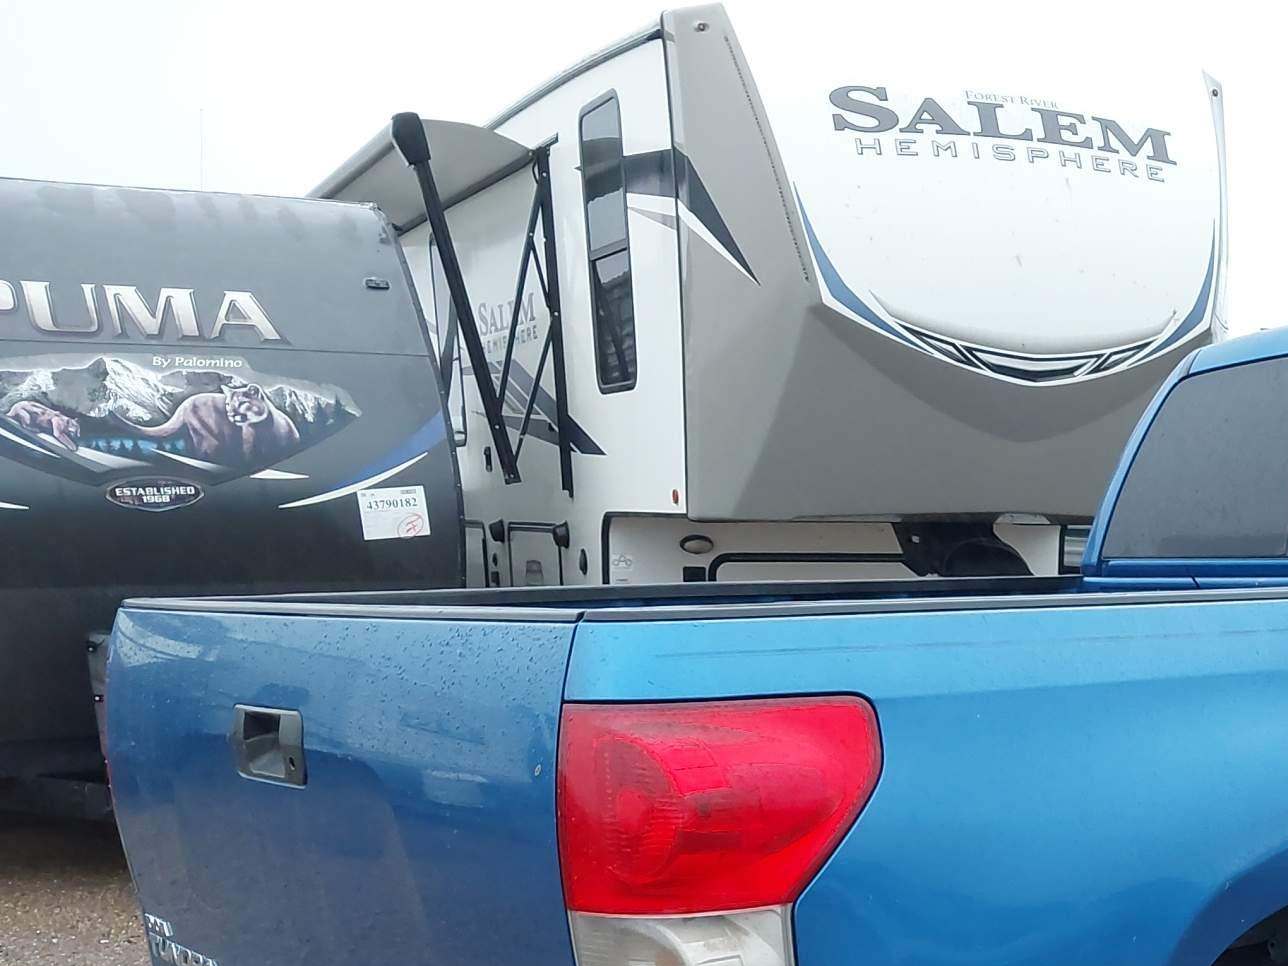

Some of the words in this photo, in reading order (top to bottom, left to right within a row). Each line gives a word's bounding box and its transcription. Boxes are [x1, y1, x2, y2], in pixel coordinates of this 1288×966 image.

[828, 85, 1178, 165] SALEM
[854, 137, 1165, 183] HEMISPHERE
[152, 356, 171, 369] By
[175, 356, 243, 369] Palomino
[115, 486, 195, 496] ESTABLISHED
[366, 497, 419, 511] 43790182
